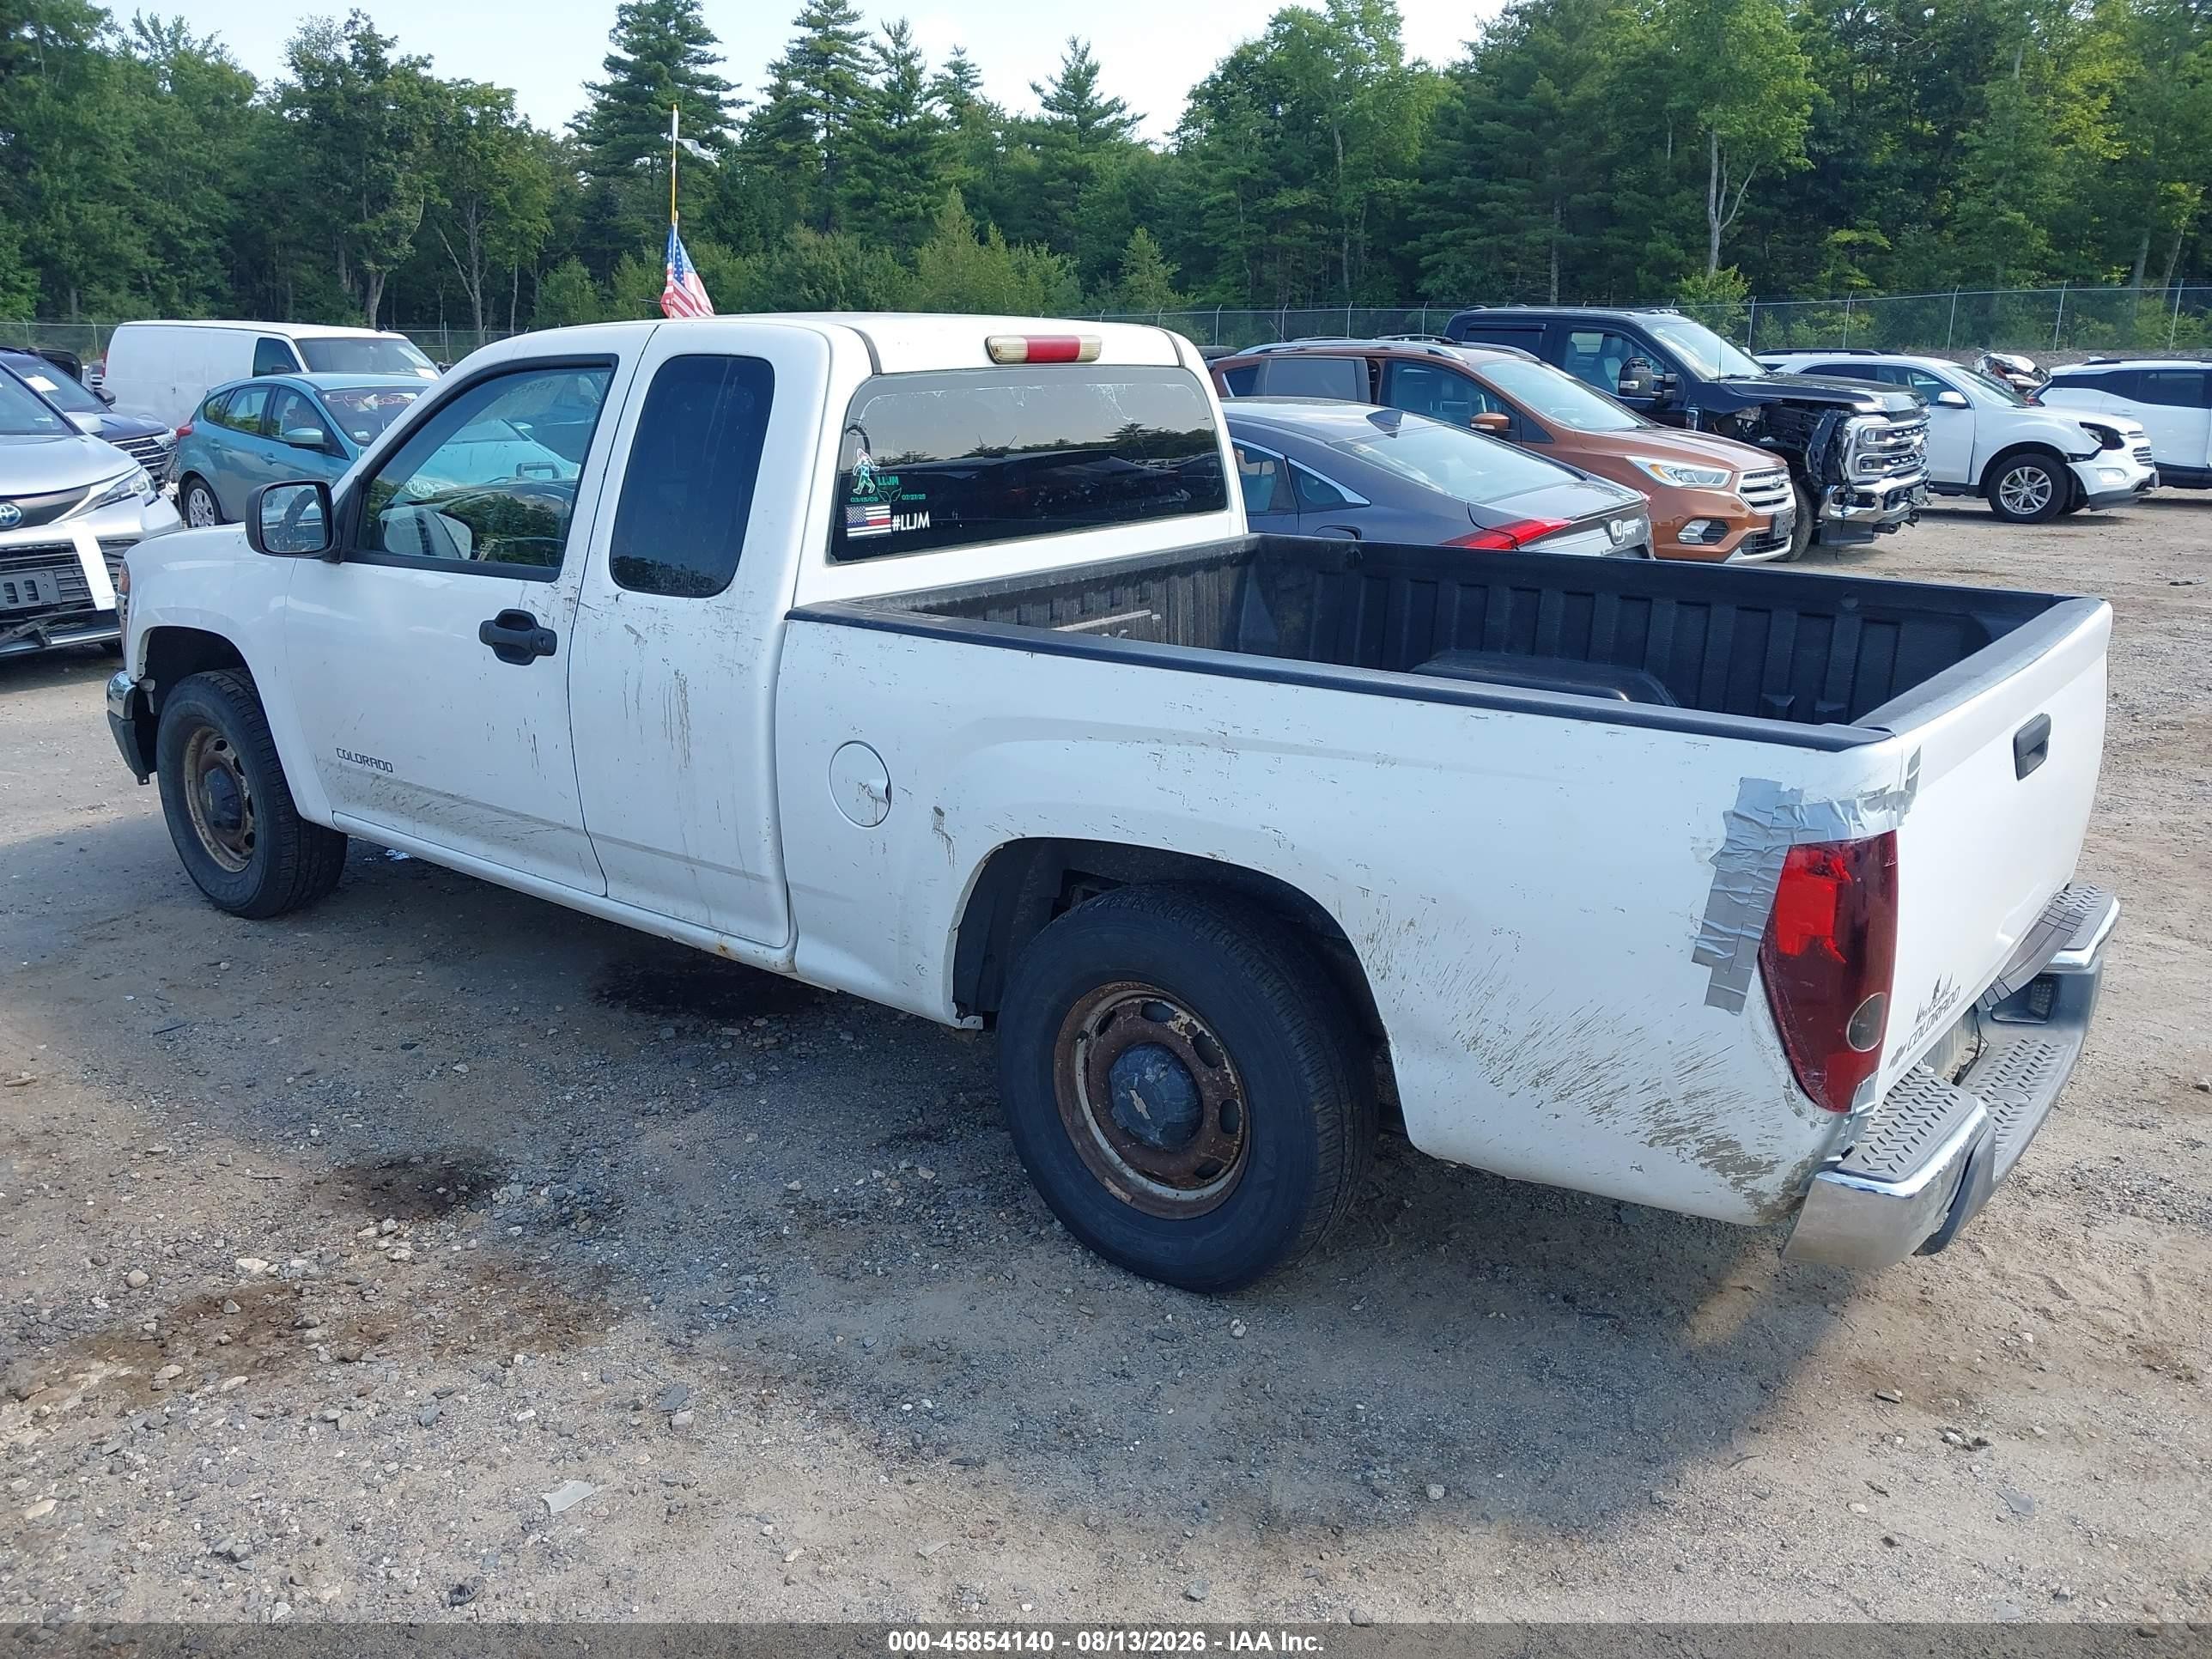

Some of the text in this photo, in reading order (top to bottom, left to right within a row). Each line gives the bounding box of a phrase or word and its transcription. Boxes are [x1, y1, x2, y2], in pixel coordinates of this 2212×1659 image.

[878, 476, 899, 486] LLJM
[892, 510, 930, 532] #LLJM
[336, 747, 393, 773] COLORADO
[1907, 985, 1961, 1052] COLORADO
